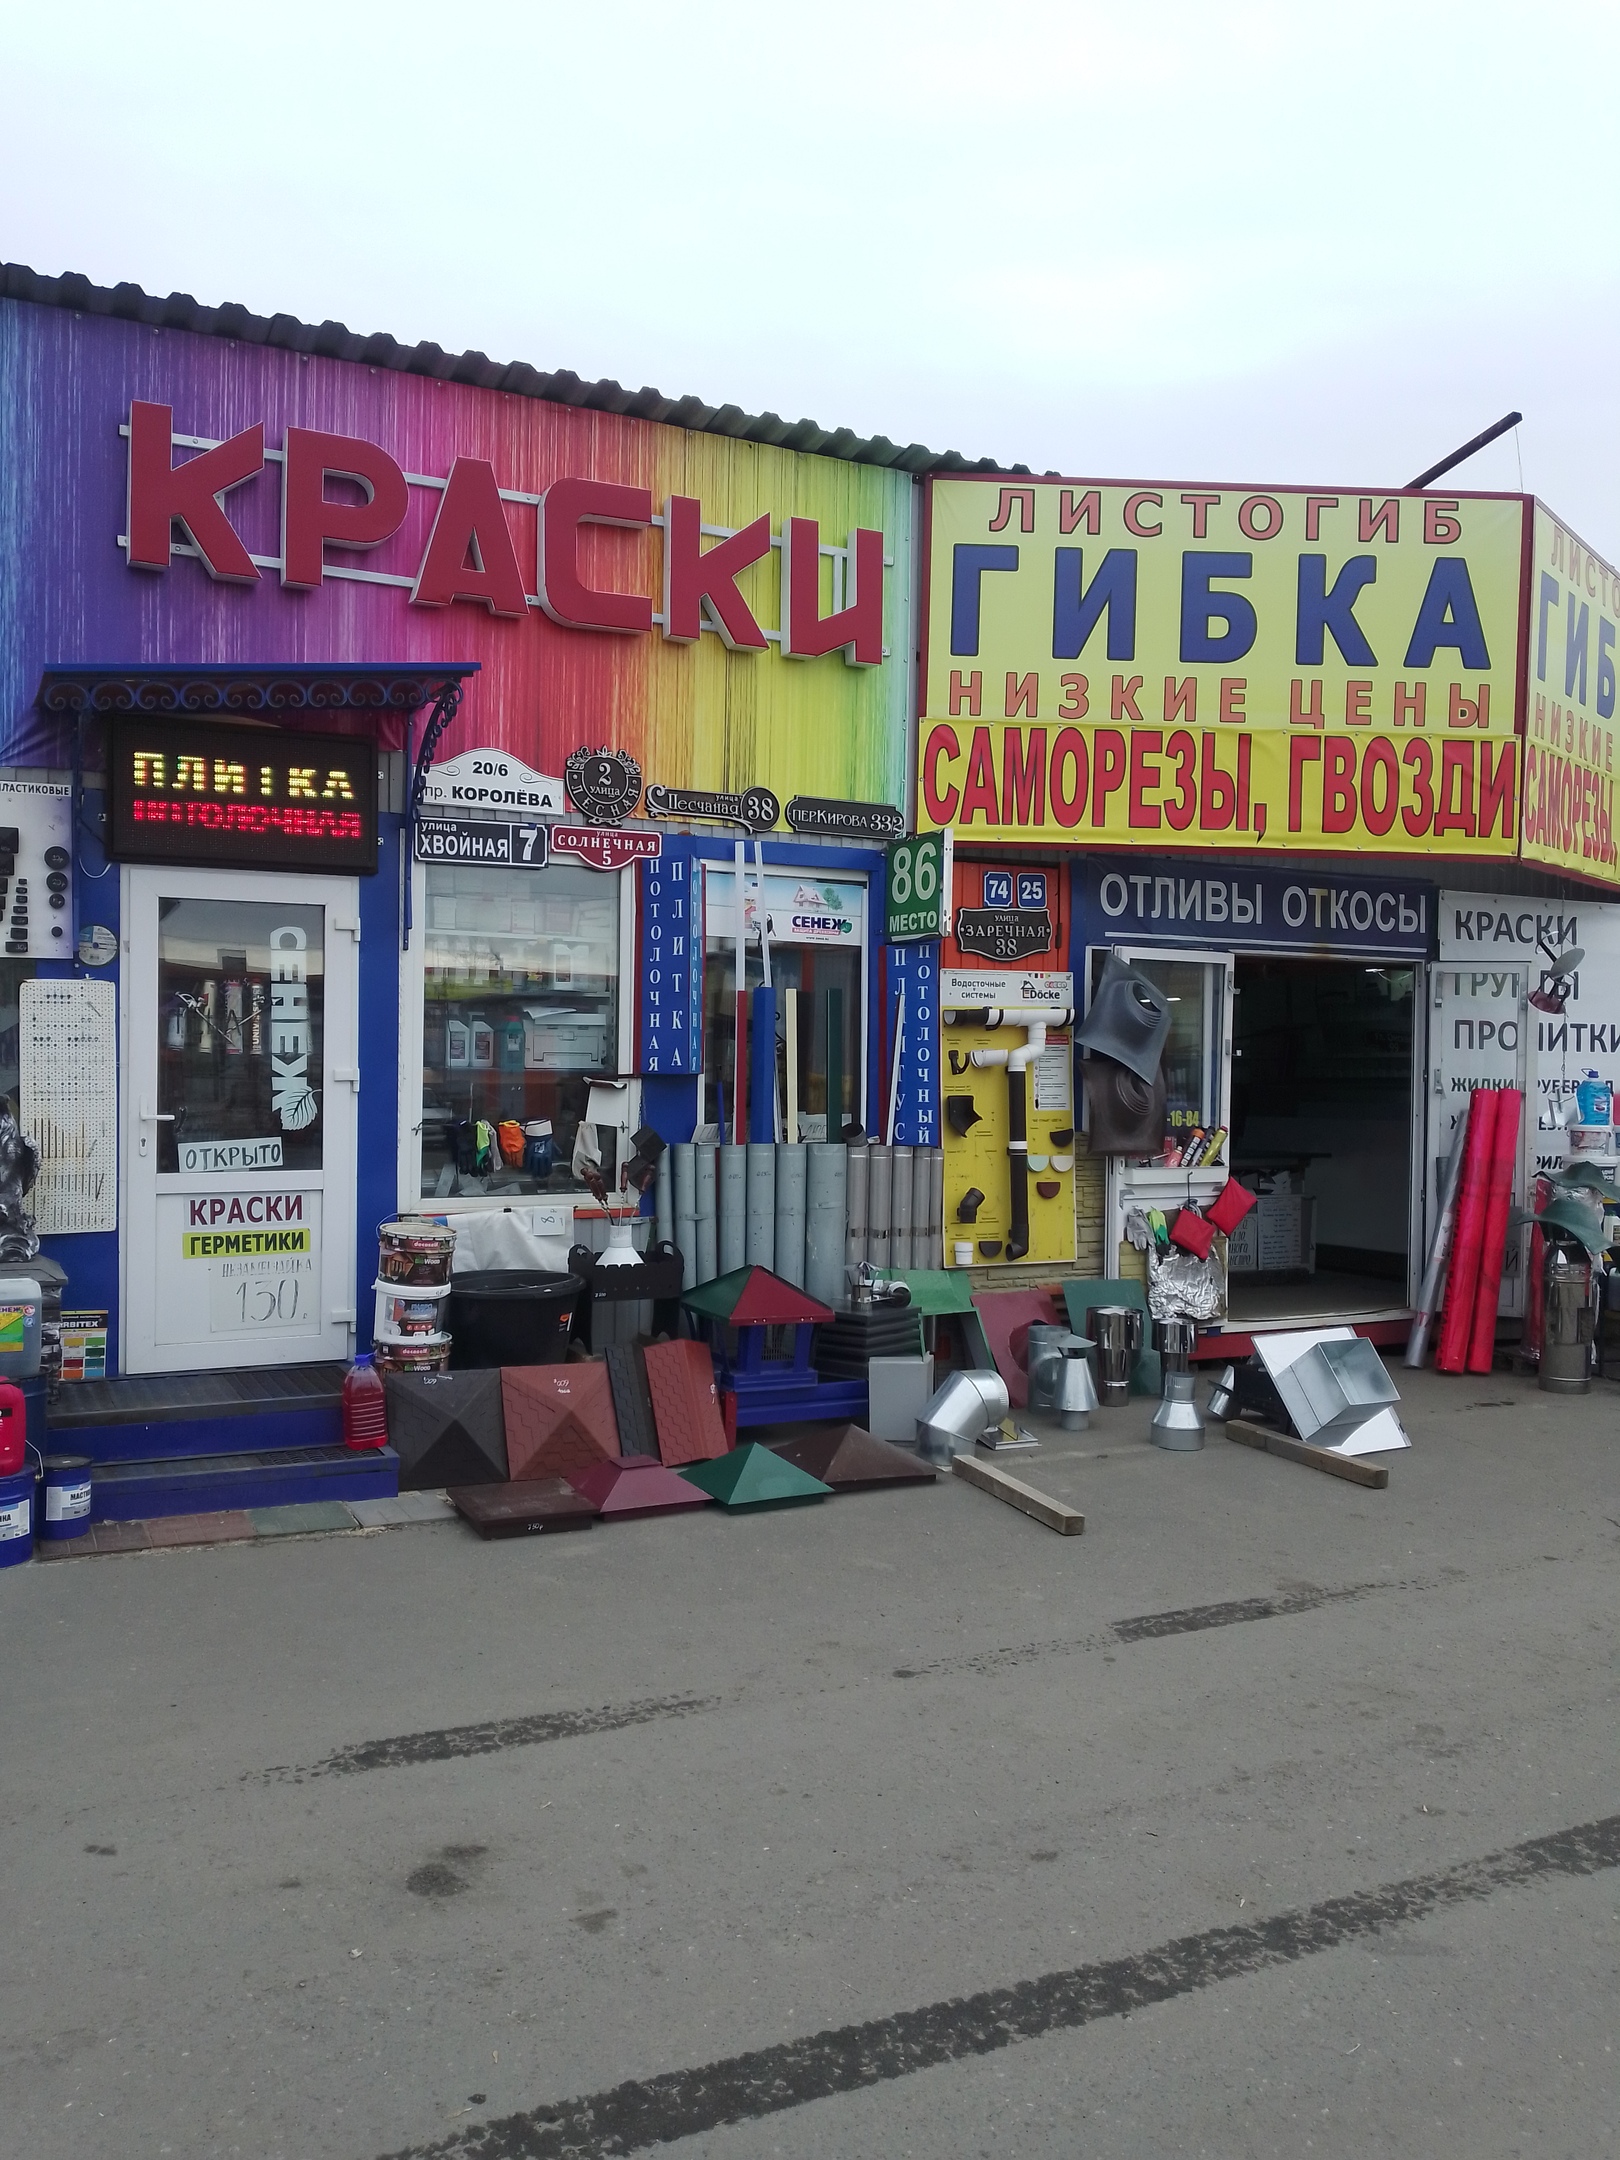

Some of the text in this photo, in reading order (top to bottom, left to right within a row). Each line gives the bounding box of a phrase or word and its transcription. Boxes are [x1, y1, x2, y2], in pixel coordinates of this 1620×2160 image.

[989, 487, 1463, 546] ЛИСТОГИБ
[126, 399, 884, 667] КРАСКИ
[949, 543, 1492, 670] ГИБКА
[1537, 570, 1616, 720] ГИБ
[949, 669, 1490, 731] НИЗКИЕ ЦЕНЫ
[1534, 691, 1614, 773] НИЗКИЕ
[472, 761, 508, 777] 20/6
[598, 762, 612, 785] 2
[0, 783, 70, 796] ЛАСТИКОВЫЕ
[425, 784, 553, 808] пр. КОРОЛЁВА
[923, 723, 1517, 844] САМОРЕЗЫ, ГВОЗДИ
[571, 785, 639, 817] ЛЕСНАЯ
[667, 793, 774, 821] Песчаная 38
[715, 794, 739, 802] улица
[421, 821, 457, 832] улица
[420, 827, 538, 861] ХВОЙНАЯ 7
[557, 834, 656, 852] СОЛНЕЧНАЯ
[602, 850, 612, 866] 5
[892, 842, 937, 904] 86
[988, 880, 1009, 899] 74
[1021, 881, 1043, 900] 25
[1100, 872, 1427, 934] ОТЛИВЫ ОТКОСЫ
[792, 915, 847, 930] СЕНЕЖ
[889, 910, 938, 933] МЕСТО
[965, 924, 1046, 937] ЗАРЕЧНАЯ
[1455, 909, 1578, 946] КРАСКИ
[995, 938, 1017, 956] 38
[648, 859, 662, 1072] ПОТОЛОЧНАЯ
[670, 861, 684, 1067] ПЛИТКА
[951, 978, 1006, 988] Водосточные
[961, 990, 996, 999] системы
[1030, 989, 1061, 1000] Döcke
[1454, 969, 1579, 1001] ГРУЫ
[270, 926, 308, 1113] СЕНЕЖ
[894, 948, 908, 1141] ПЛТУС
[917, 945, 934, 1144] ПОТОЛОЧНЫЙ
[1454, 1019, 1620, 1053] ПРОИТКИ
[185, 1143, 281, 1170] ОТКРЫТО
[189, 1195, 302, 1226] КРАСКИ
[190, 1232, 304, 1255] ГЕРМЕТИКИ
[60, 1320, 99, 1328] RBITEX
